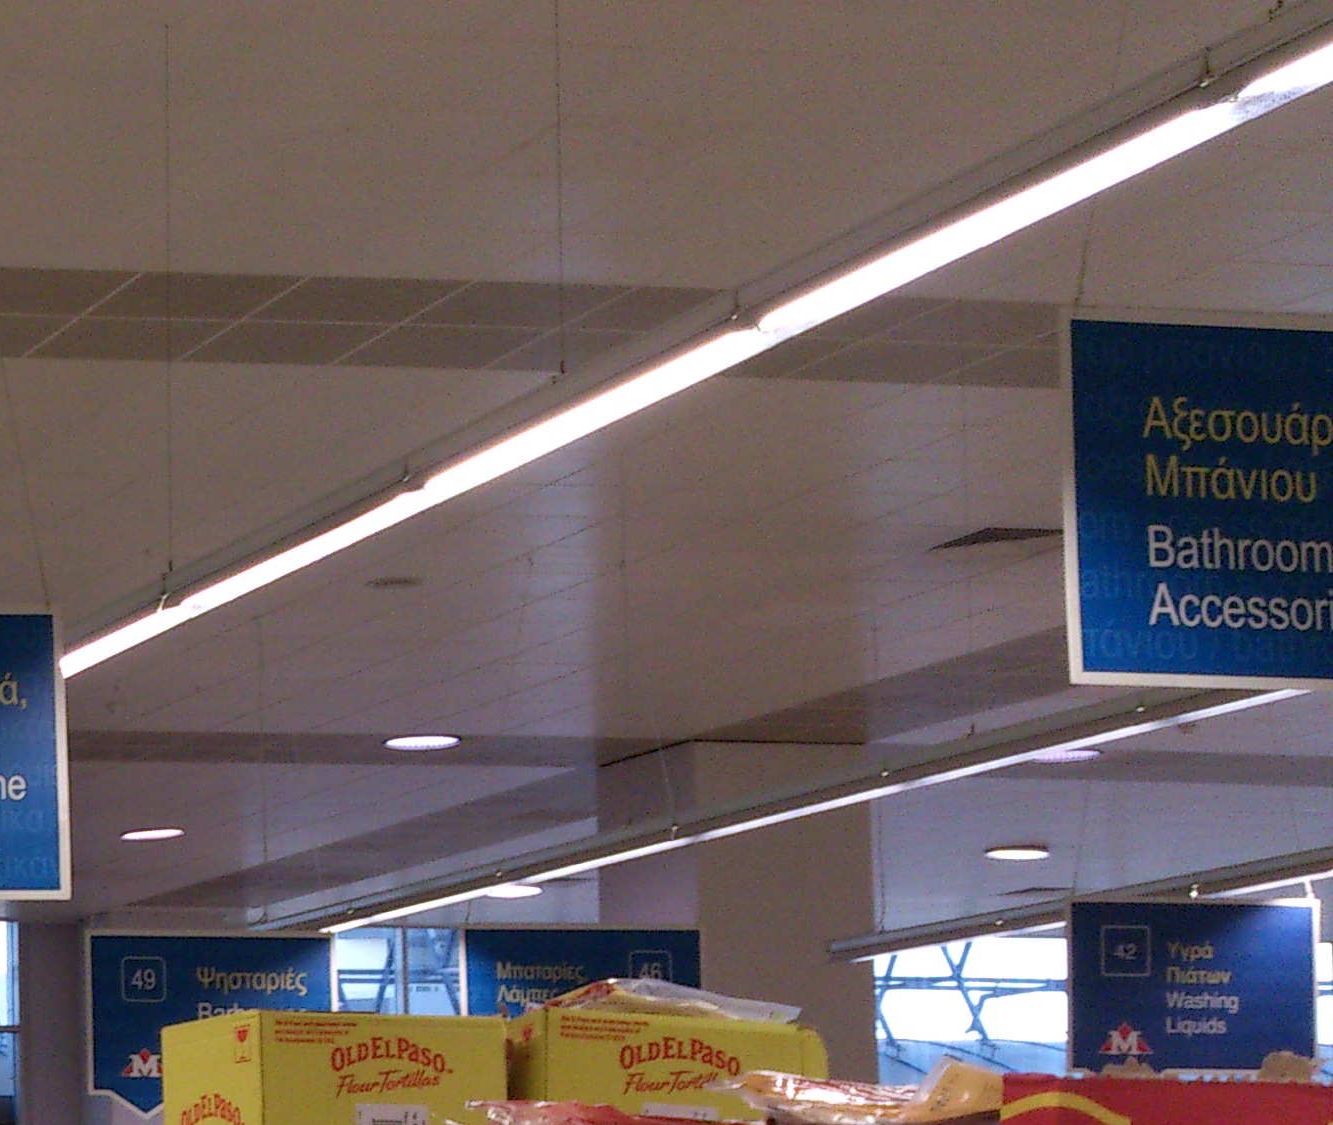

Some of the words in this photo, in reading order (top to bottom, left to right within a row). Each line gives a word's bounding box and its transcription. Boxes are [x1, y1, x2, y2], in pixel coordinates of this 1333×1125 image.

[1145, 454, 1318, 502] Μπάνιου
[1148, 524, 1333, 573] Bathroom
[131, 969, 155, 990] 49
[196, 967, 308, 996] Ψησταριές
[1166, 992, 1239, 1014] Washing
[1166, 1017, 1227, 1037] Liquids
[337, 1074, 380, 1097] Flour
[378, 1069, 439, 1093] Tortillas
[623, 1072, 671, 1095] Flour
